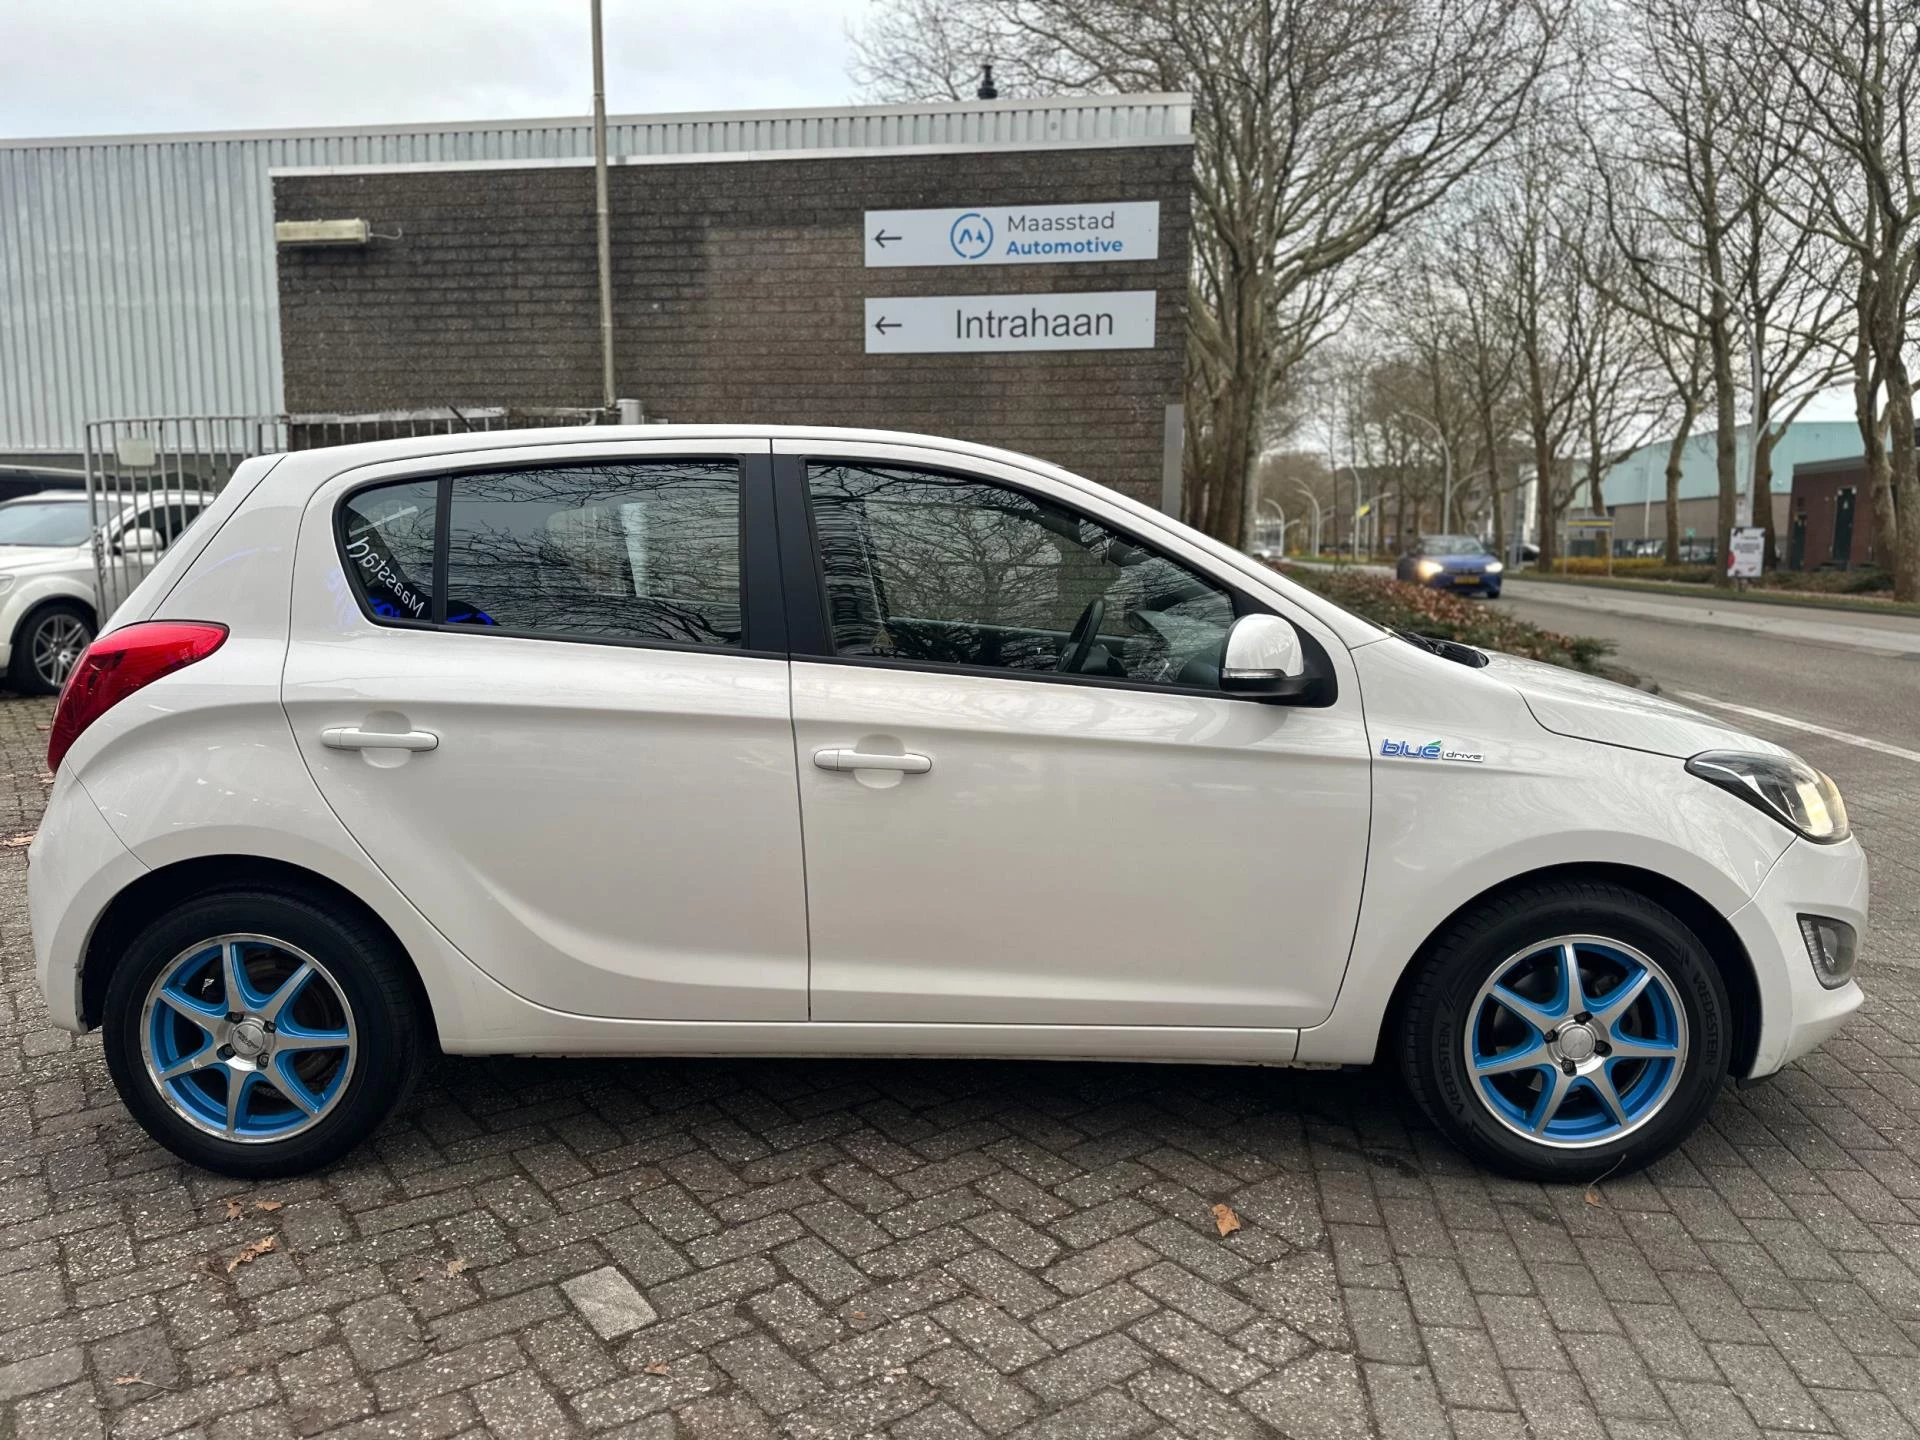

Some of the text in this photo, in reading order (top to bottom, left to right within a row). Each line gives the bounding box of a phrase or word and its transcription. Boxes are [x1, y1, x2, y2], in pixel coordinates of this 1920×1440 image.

[1007, 211, 1115, 233] Maasstad
[1006, 237, 1123, 255] Automotive
[956, 308, 1114, 339] Intrahaan
[1445, 751, 1482, 760] drive
[1692, 971, 1719, 1066] VREDESTEIN
[1438, 1020, 1465, 1115] VREDESTEIN
